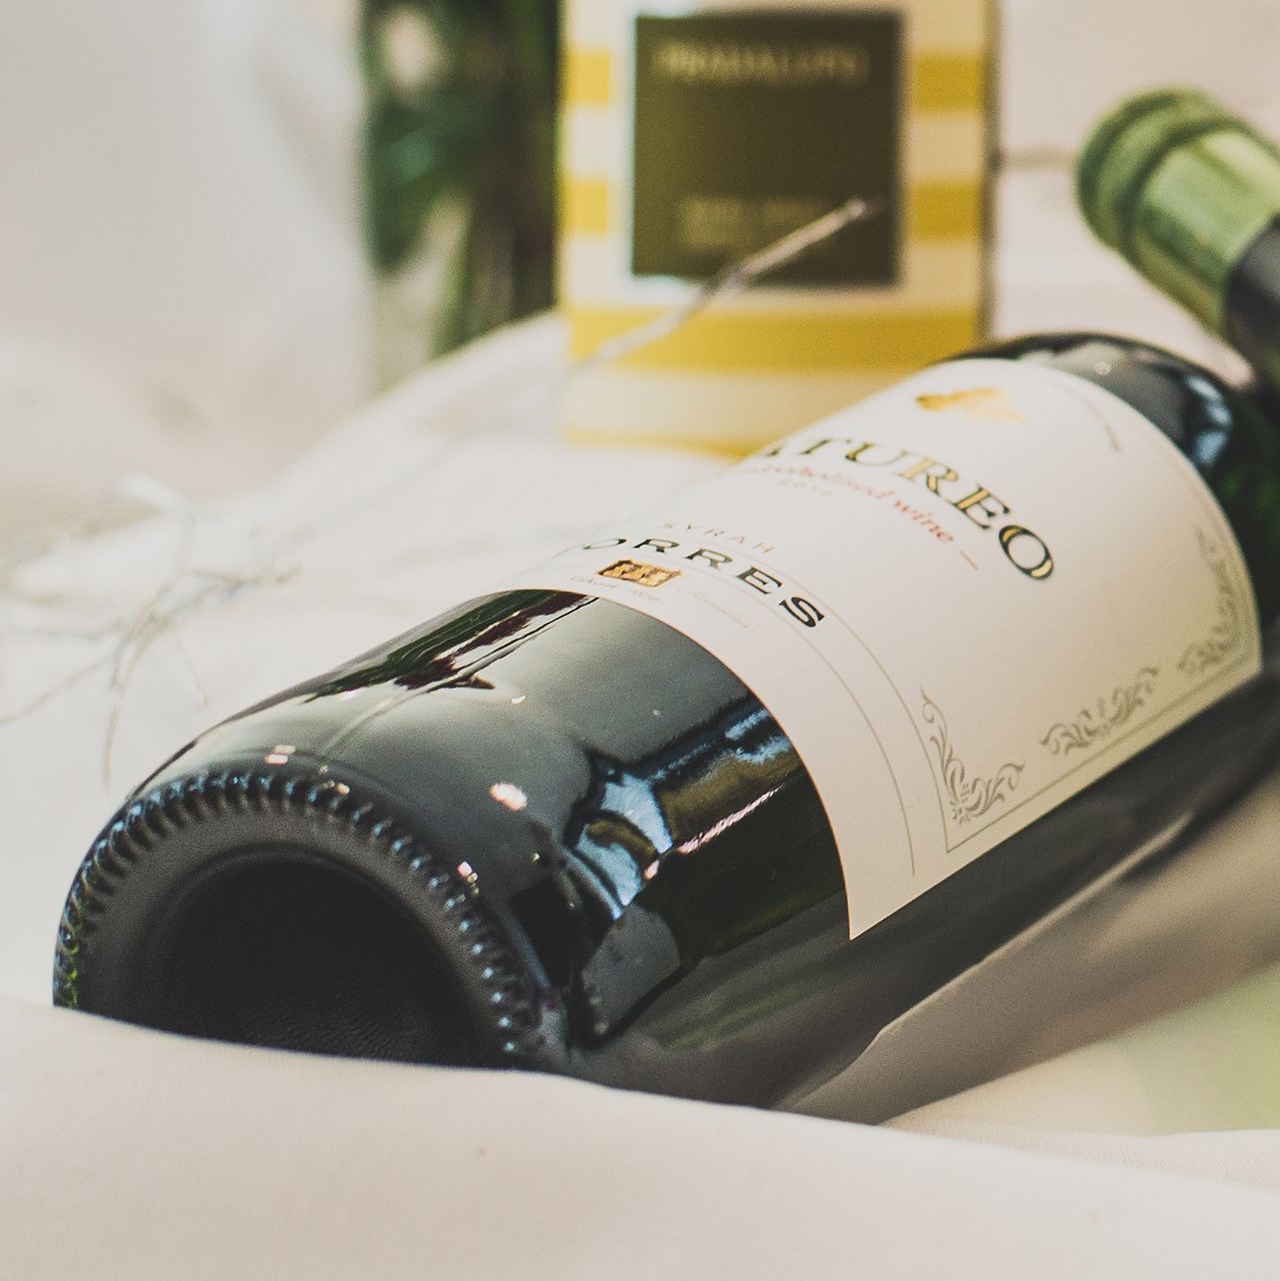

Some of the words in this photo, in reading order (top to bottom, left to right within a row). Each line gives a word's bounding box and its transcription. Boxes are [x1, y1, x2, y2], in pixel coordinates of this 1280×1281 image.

[765, 438, 1055, 581] TUREO
[892, 499, 955, 543] wine
[583, 537, 826, 628] ORRES
